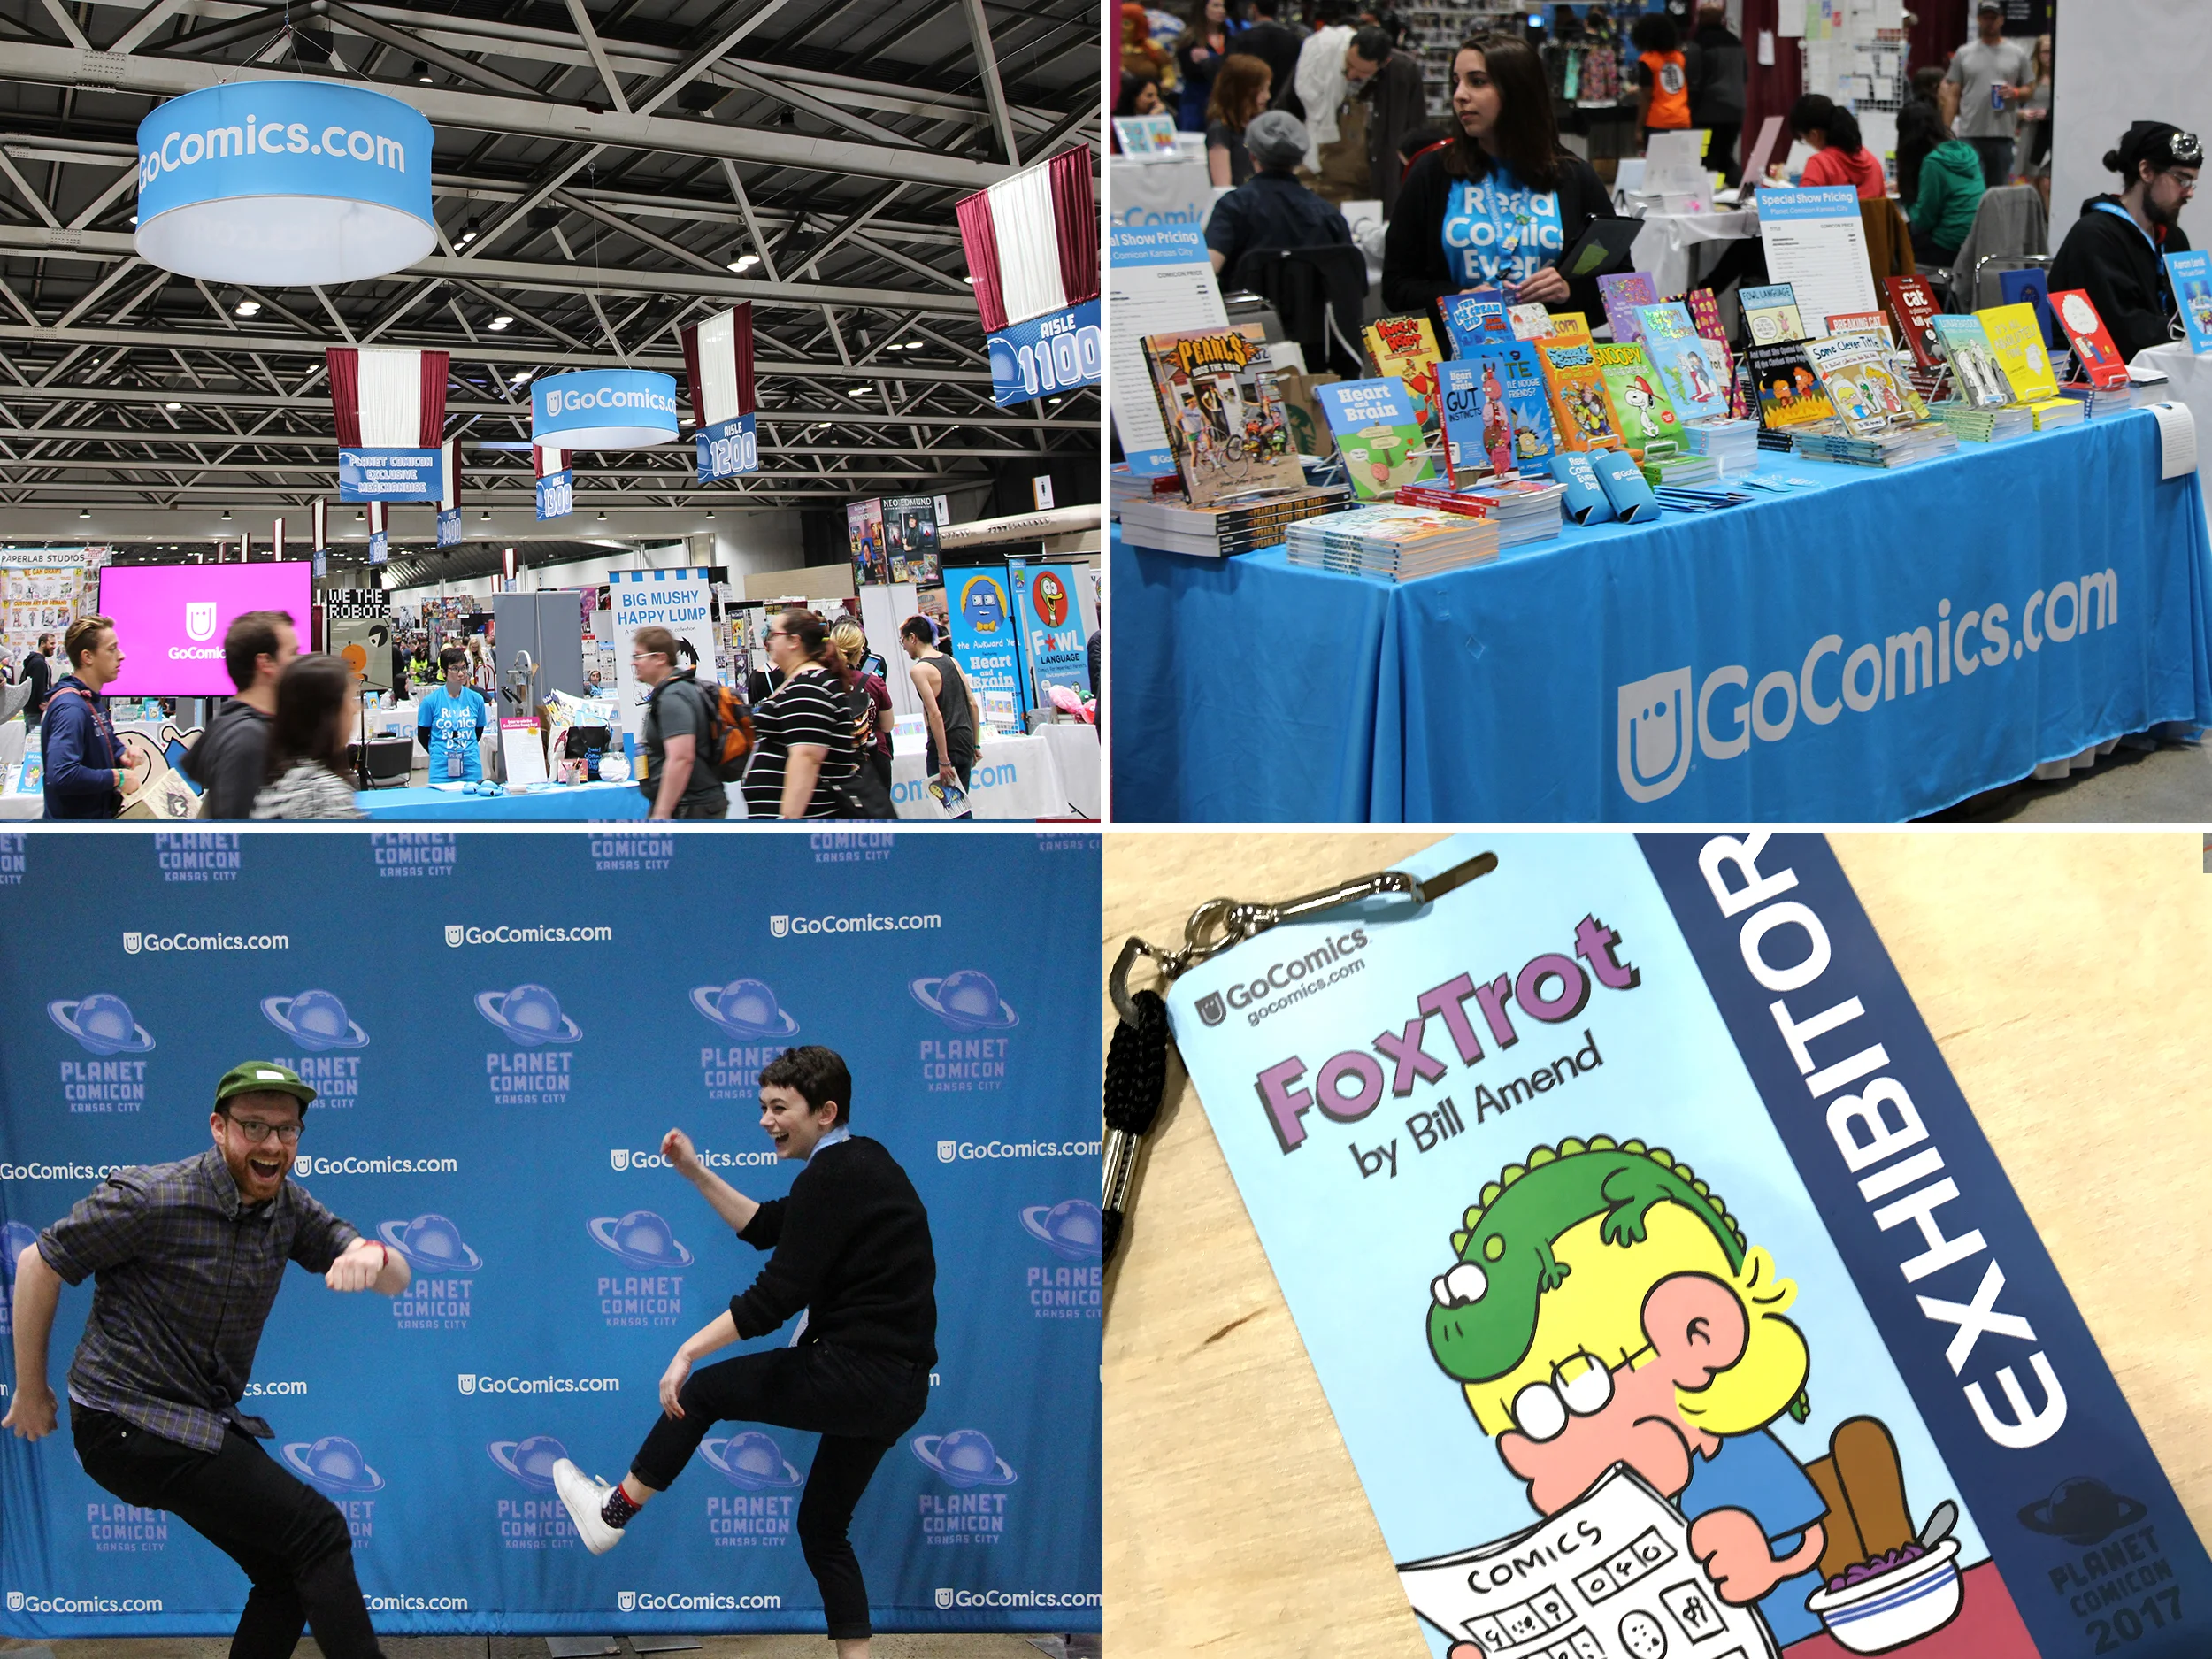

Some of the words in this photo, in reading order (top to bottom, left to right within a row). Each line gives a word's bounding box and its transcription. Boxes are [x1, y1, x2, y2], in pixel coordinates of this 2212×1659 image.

[138, 114, 405, 194] GoComics.com
[1762, 194, 1796, 206] Special
[1797, 193, 1821, 204] Show
[1823, 192, 1854, 204] Pricing
[1837, 204, 1848, 213] City
[1122, 233, 1156, 246] Show
[1157, 231, 1199, 245] Pricing
[1113, 251, 1149, 260] Comicon
[1150, 249, 1178, 257] Kansas
[1179, 248, 1194, 257] City
[1742, 288, 1760, 301] FOWL
[1761, 286, 1791, 298] LANGUAGE
[1902, 289, 1928, 307] cat
[1040, 313, 1076, 338] AISLE
[1833, 317, 1869, 330] BREAKING
[1869, 316, 1881, 326] CAT
[1386, 333, 1423, 354] ROBOT
[1813, 346, 1837, 361] Some
[1838, 338, 1861, 351] Clever
[1859, 335, 1880, 349] Title
[1018, 325, 1101, 395] 1100
[1178, 332, 1248, 377] PEARLS
[1595, 346, 1642, 368] SNOOPY
[1449, 371, 1472, 380] Heart
[1603, 368, 1614, 377] TO
[1614, 367, 1626, 376] THE
[1626, 365, 1650, 375] RESCUE
[1451, 381, 1474, 391] Brain
[1517, 378, 1540, 388] NOOGIE
[1337, 385, 1392, 403] Heart
[1447, 387, 1479, 412] GUT
[1509, 388, 1536, 398] FRIENDS?
[1344, 401, 1399, 422] Brain
[1448, 407, 1483, 423] INSTINCTS
[724, 421, 743, 437] AISLE
[349, 457, 387, 467] PLANET
[390, 457, 433, 467] COMICON
[710, 431, 757, 476] 1200
[367, 469, 418, 480] EXCLUSIVE
[552, 475, 565, 487] AISLE
[357, 482, 426, 493] MERCHANDISE
[1586, 481, 1601, 492] Day
[544, 483, 572, 517] 1300
[901, 497, 932, 506] EDMUND
[1253, 505, 1277, 517] PEARLS
[1294, 500, 1306, 509] THE
[1253, 517, 1277, 527] PEARLS
[1294, 510, 1306, 520] THE
[329, 589, 350, 603] WE
[355, 589, 383, 603] THE
[622, 592, 647, 607] BIG
[651, 590, 699, 605] MUSHY
[329, 604, 391, 618] ROBOTS
[618, 609, 664, 625] HAPPY
[669, 607, 707, 622] LUMP
[957, 641, 970, 650] the
[973, 638, 1004, 649] Awkward
[970, 655, 1012, 670] Heart
[1041, 653, 1080, 664] LANGUAGE
[1697, 567, 2119, 761] GoComics.com
[374, 845, 457, 864] COMICON
[591, 840, 674, 857] COMICON
[865, 849, 890, 861] CITY
[159, 851, 241, 869] COMICON
[596, 859, 640, 871] KANSAS
[645, 859, 670, 870] CITY
[380, 866, 424, 877] KANSAS
[428, 865, 453, 876] CITY
[790, 912, 941, 934] GoComics.com
[143, 931, 289, 952] GoComics.com
[466, 924, 612, 945] GoComics.com
[1225, 927, 1370, 1012] GoComics
[1247, 956, 1367, 1026] gocomics.com
[1254, 912, 1641, 1156] FoxTrot
[919, 1038, 1008, 1060] PLANET
[487, 1051, 572, 1073] PLANET
[923, 1060, 1005, 1079] COMICON
[61, 1061, 147, 1083] PLANET
[65, 1082, 144, 1101] COMICON
[490, 1074, 570, 1093] COMICON
[979, 1080, 1002, 1091] CITY
[495, 1094, 538, 1104] KANSAS
[542, 1094, 565, 1104] CITY
[709, 1088, 752, 1100] KANSAS
[70, 1102, 112, 1113] KANSAS
[1348, 1138, 1399, 1179] by
[1405, 1095, 1466, 1153] Bill
[1477, 1028, 1605, 1125] Amend
[957, 1139, 1102, 1161] GoComics.com
[1698, 833, 2069, 1449] EXHIBITOR
[313, 1155, 457, 1175] GoComics.com
[597, 1276, 683, 1297] PLANET
[392, 1301, 472, 1317] COMICON
[602, 1296, 680, 1316] COMICON
[397, 1319, 440, 1329] KANSAS
[444, 1319, 467, 1329] CITY
[606, 1316, 649, 1326] KANSAS
[653, 1316, 678, 1326] CITY
[478, 1372, 619, 1394] GoComics.com
[707, 1495, 793, 1517] PLANET
[918, 1494, 1007, 1515] PLANET
[91, 1522, 168, 1540] COMICON
[710, 1516, 790, 1535] COMICON
[922, 1514, 1003, 1533] COMICON
[96, 1542, 137, 1552] KANSAS
[762, 1535, 786, 1546] CITY
[926, 1534, 970, 1545] KANSAS
[975, 1533, 999, 1544] CITY
[1467, 1520, 1602, 1594] COMICS
[2047, 1525, 2159, 1596] PLANET
[2069, 1557, 2174, 1617] COMICON
[25, 1594, 163, 1615] GoComics.com
[638, 1592, 780, 1610] GoComics.com
[956, 1589, 1102, 1609] GoComics.com
[2085, 1584, 2183, 1655] 2017
